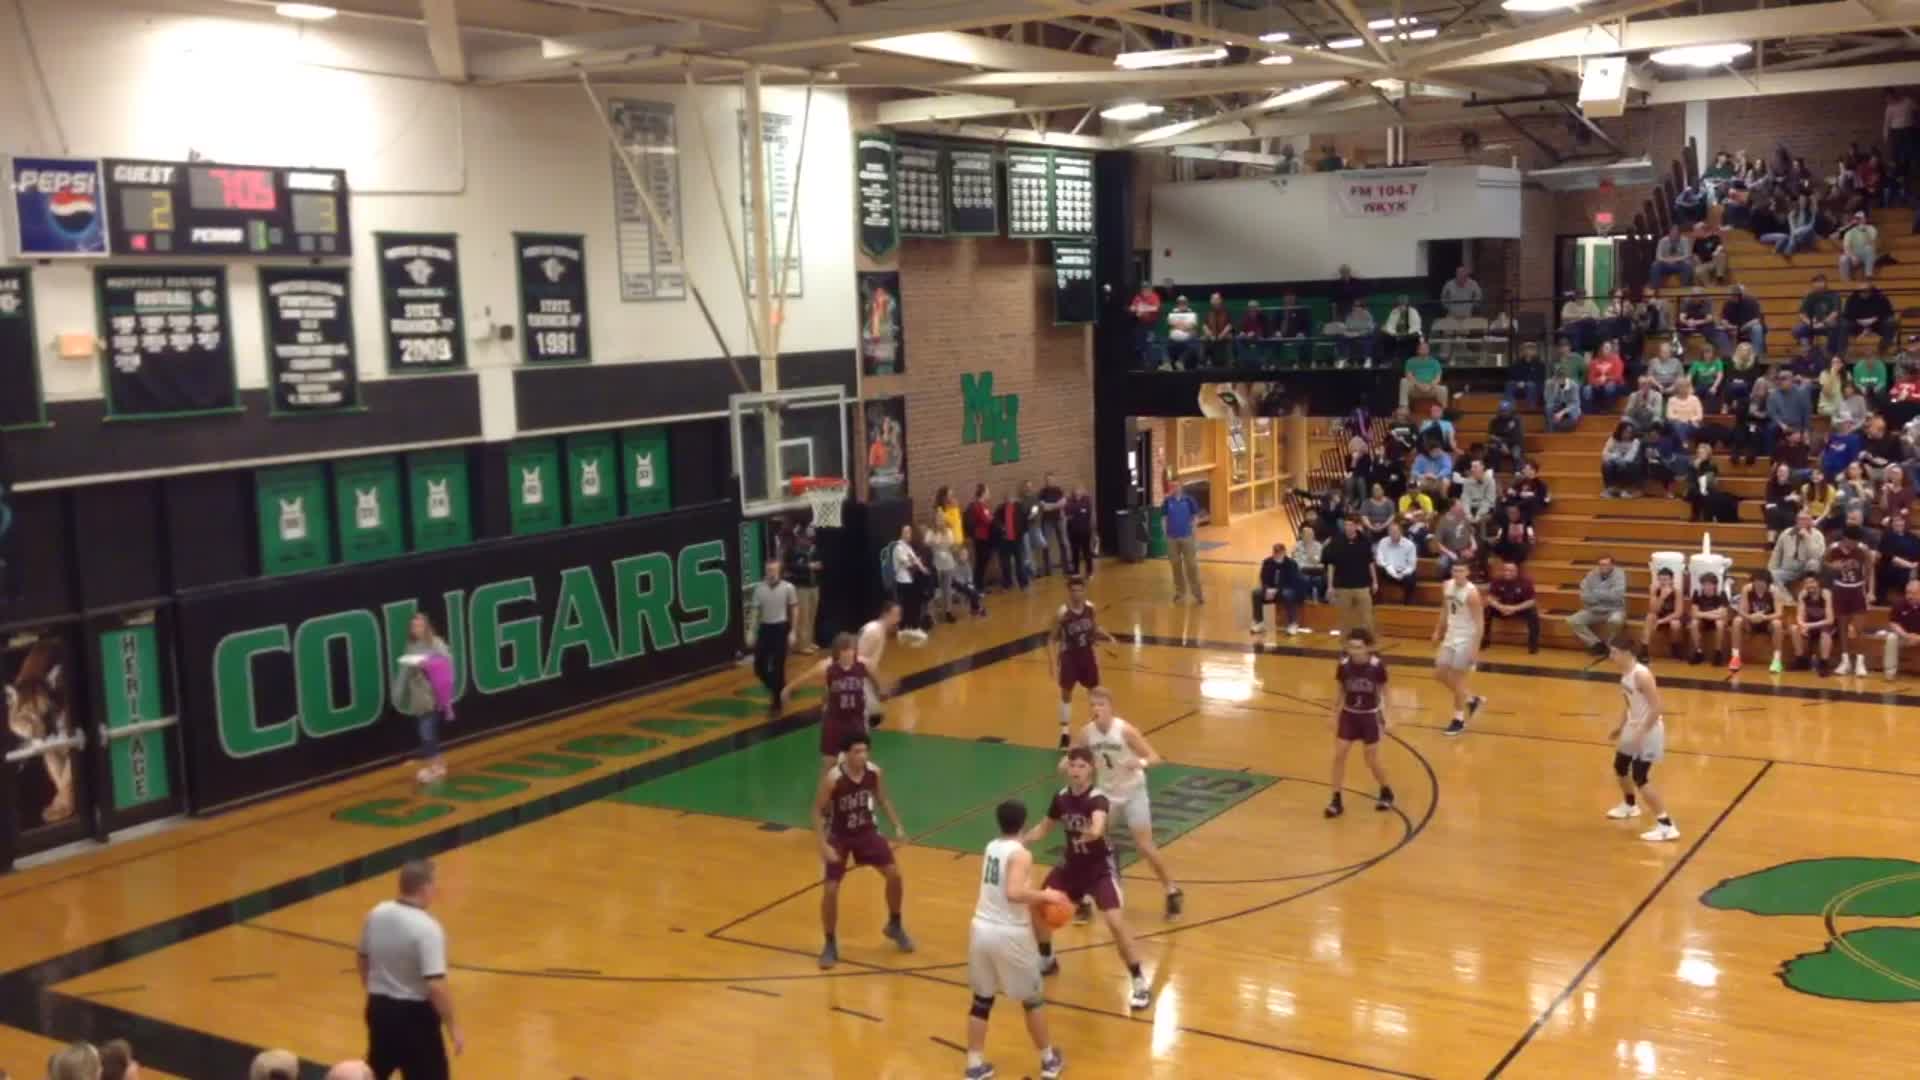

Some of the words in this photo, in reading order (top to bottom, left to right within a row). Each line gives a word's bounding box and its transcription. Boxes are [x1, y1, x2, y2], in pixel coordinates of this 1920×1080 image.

[14, 170, 96, 194] PEPSI
[113, 165, 173, 184] GUEST
[151, 191, 173, 230] 2
[213, 540, 729, 759] COUGARS
